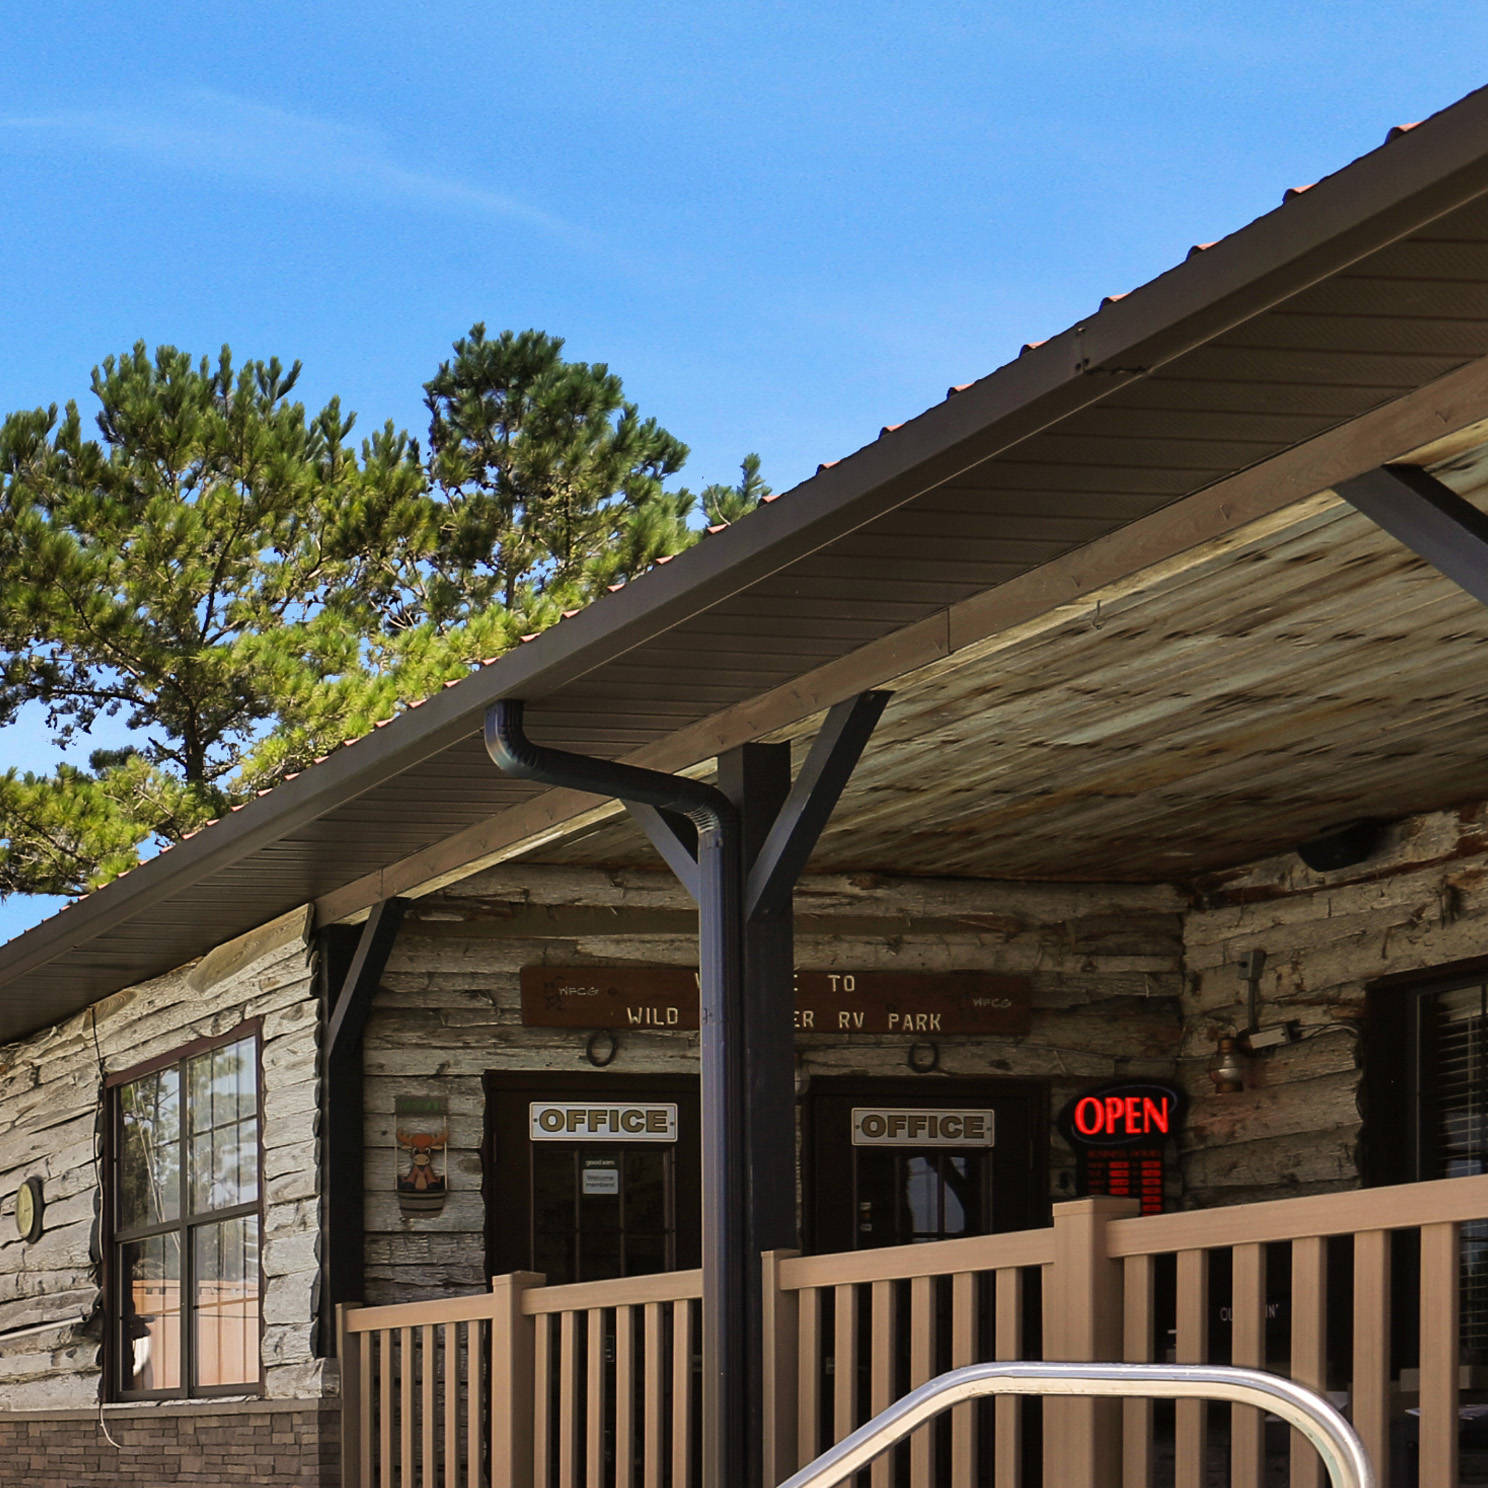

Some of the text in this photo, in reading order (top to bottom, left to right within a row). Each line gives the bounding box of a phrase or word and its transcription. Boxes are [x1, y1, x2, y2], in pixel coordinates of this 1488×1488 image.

[827, 974, 856, 992] TO
[626, 1006, 679, 1026] WILD
[839, 1011, 865, 1029] RV
[888, 1013, 942, 1032] PARK
[539, 1109, 668, 1133] OFFICE
[861, 1114, 985, 1139] OFFICE
[1074, 1096, 1169, 1135] OPEN
